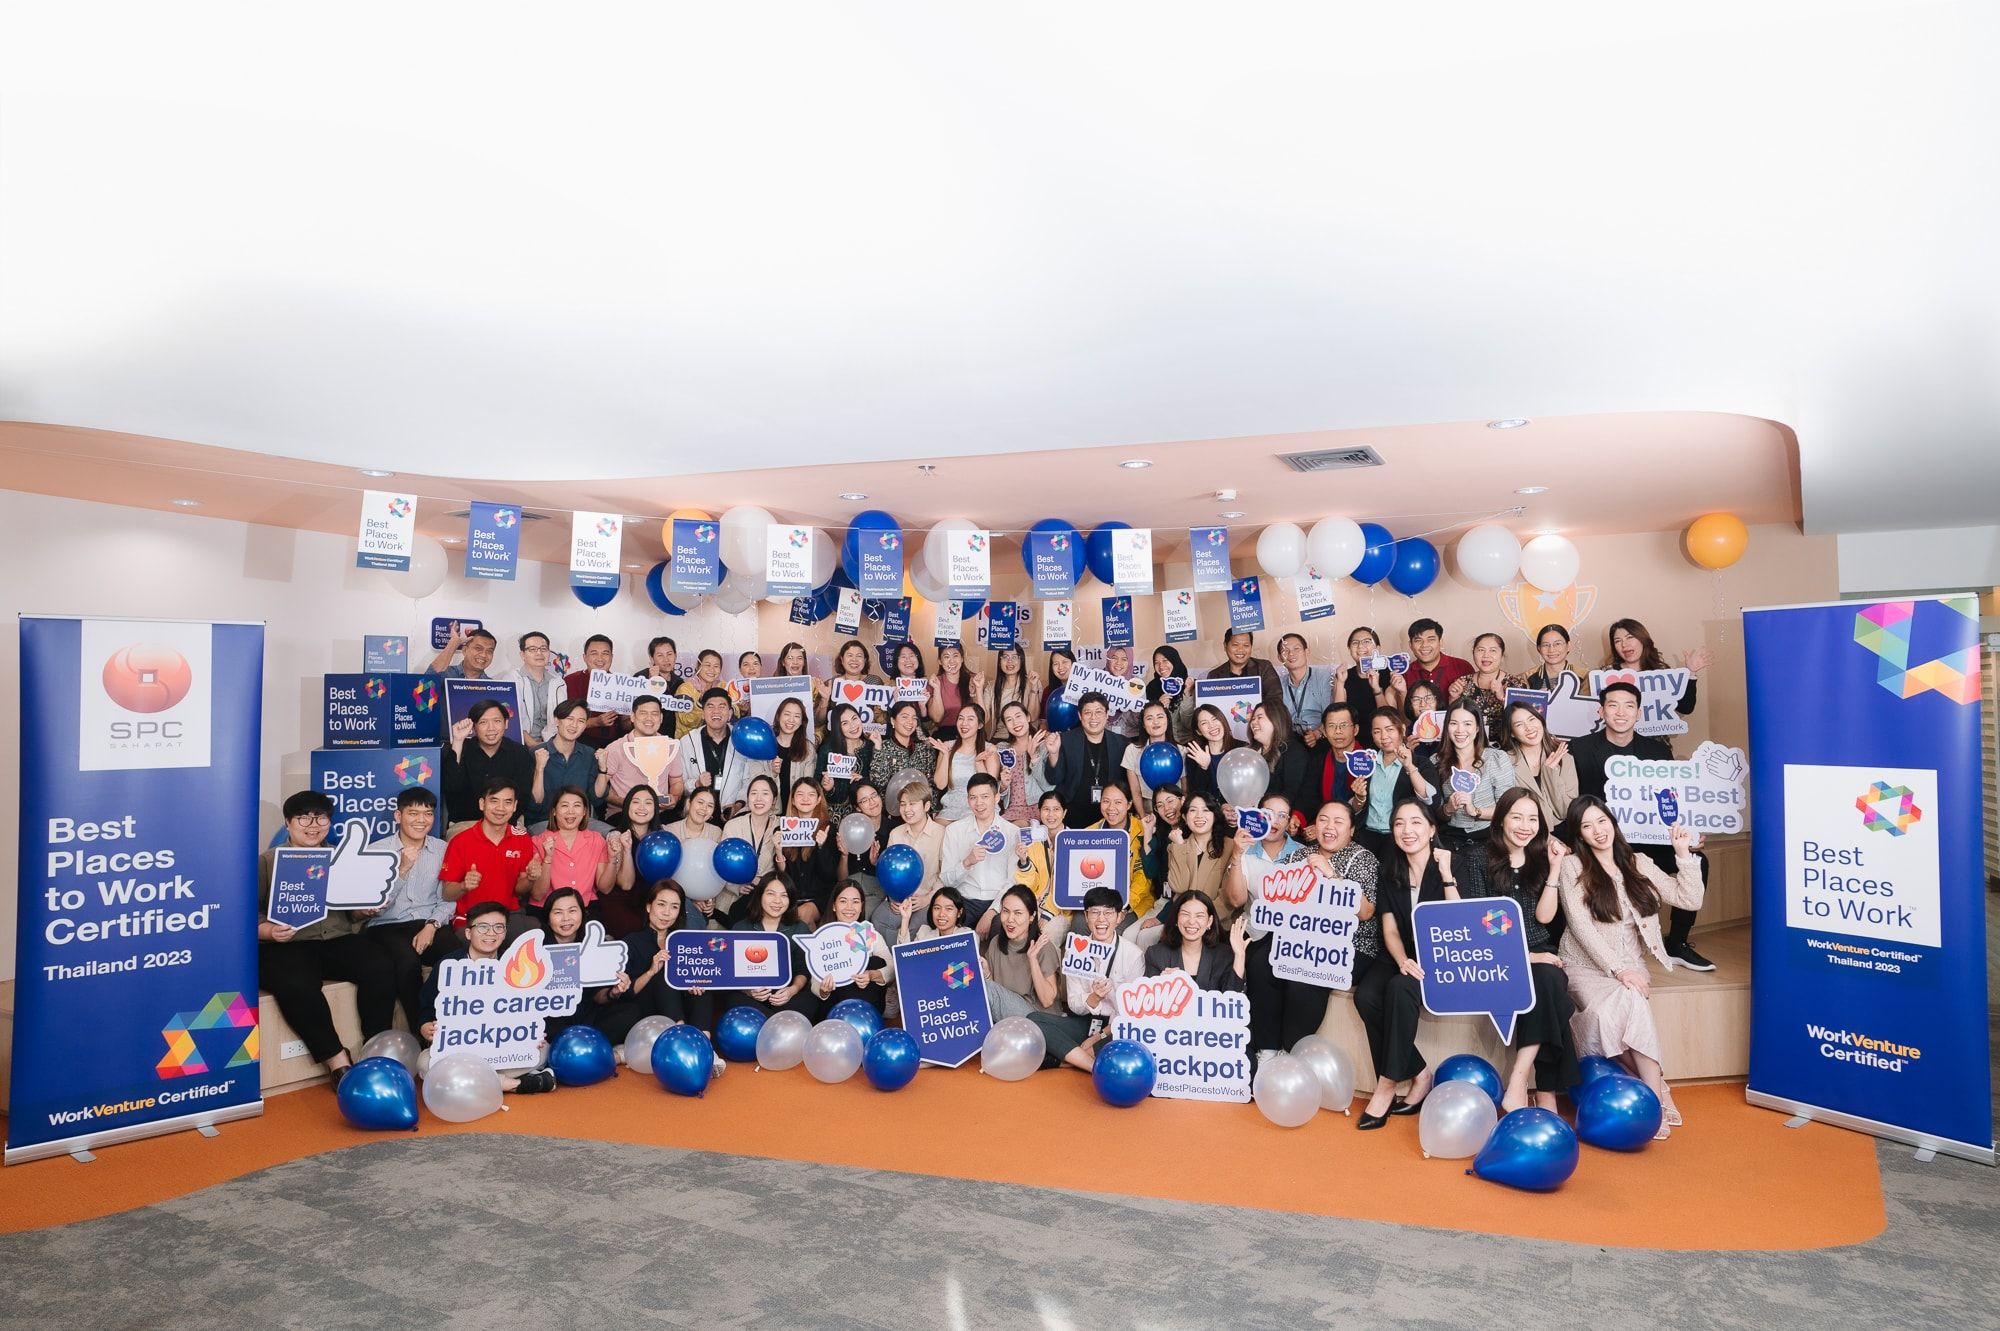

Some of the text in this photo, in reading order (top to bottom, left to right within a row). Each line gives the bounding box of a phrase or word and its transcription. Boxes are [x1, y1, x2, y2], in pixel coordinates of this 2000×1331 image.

[366, 518, 389, 529] Best
[365, 529, 398, 540] Places
[473, 529, 496, 540] Best
[364, 540, 377, 549] to
[473, 540, 504, 551] Places
[577, 538, 597, 548] Best
[472, 550, 483, 559] to
[576, 548, 607, 559] Places
[677, 545, 697, 555] Best
[772, 551, 791, 559] Best
[1195, 550, 1212, 558] Best
[575, 559, 587, 567] to
[677, 555, 706, 565] Places
[864, 553, 883, 562] Best
[952, 555, 970, 563] Best
[1037, 555, 1054, 563] Best
[676, 565, 687, 573] to
[771, 560, 800, 569] Places
[864, 562, 891, 572] Places
[953, 564, 979, 572] Places
[1037, 564, 1062, 572] Places
[771, 569, 782, 577] to
[864, 572, 874, 580] to
[953, 573, 962, 581] to
[1300, 591, 1323, 599] Places
[1231, 599, 1246, 607] Best
[1232, 605, 1253, 613] Places
[1085, 649, 1102, 660] hit
[592, 671, 646, 689] My Work
[1073, 665, 1125, 690] My Work
[1594, 672, 1684, 695] I my
[898, 689, 921, 697] work
[1068, 680, 1089, 694] is a
[329, 687, 356, 700] Best
[590, 688, 691, 711] is a Place
[835, 682, 894, 705] I my
[329, 702, 369, 715] Places
[394, 705, 408, 713] Best
[394, 713, 413, 721] Places
[110, 721, 183, 739] SPC
[329, 718, 342, 731] to
[394, 721, 416, 730] to Work
[109, 741, 183, 749] SAHAPAT
[841, 757, 856, 766] my
[828, 765, 850, 773] work
[1610, 760, 1700, 779] Cheers!
[323, 770, 376, 790] Best
[1609, 784, 1739, 805] to Best
[48, 815, 137, 844] Best
[799, 820, 817, 830] my
[781, 831, 812, 841] work
[1803, 841, 1864, 867] Best
[47, 849, 176, 878] Places
[279, 881, 305, 891] Best
[1804, 867, 1894, 897] Places
[44, 874, 196, 912] to Work
[278, 892, 315, 902] Places
[1318, 884, 1324, 904] I
[1329, 885, 1356, 908] hit
[277, 903, 320, 914] to Work
[1802, 896, 1830, 917] to
[1255, 906, 1352, 936] the career
[1429, 926, 1472, 943] Best
[677, 944, 703, 954] Best
[819, 939, 842, 951] Join
[1067, 935, 1111, 960] I my
[1806, 938, 1870, 956] WorkVenture
[821, 951, 839, 962] our
[901, 946, 940, 958] WorkVenture
[1274, 936, 1348, 967] jackpot
[1432, 946, 1494, 964] Places
[43, 949, 193, 982] Thailand 2023
[677, 955, 715, 965] Places
[823, 958, 853, 973] team!
[1064, 954, 1092, 972] Job
[1827, 954, 1901, 974] Thailand 2023
[445, 965, 495, 987] I hit
[676, 966, 722, 976] to Work
[1277, 964, 1346, 984] #BestPlacestoWork
[1434, 968, 1455, 984] to
[442, 993, 576, 1017] the career
[917, 995, 950, 1013] Best
[1197, 996, 1203, 1017] I
[1212, 997, 1244, 1019] hit
[919, 1010, 967, 1028] Places
[437, 1021, 538, 1052] jackpot
[921, 1031, 938, 1044] to
[1117, 1022, 1244, 1049] the career
[1806, 1023, 1921, 1060] WorkVenture
[1155, 1054, 1244, 1083] ackpot
[1156, 1083, 1245, 1097] #BestPlacestoWork
[48, 1097, 156, 1127] WorkVenture
